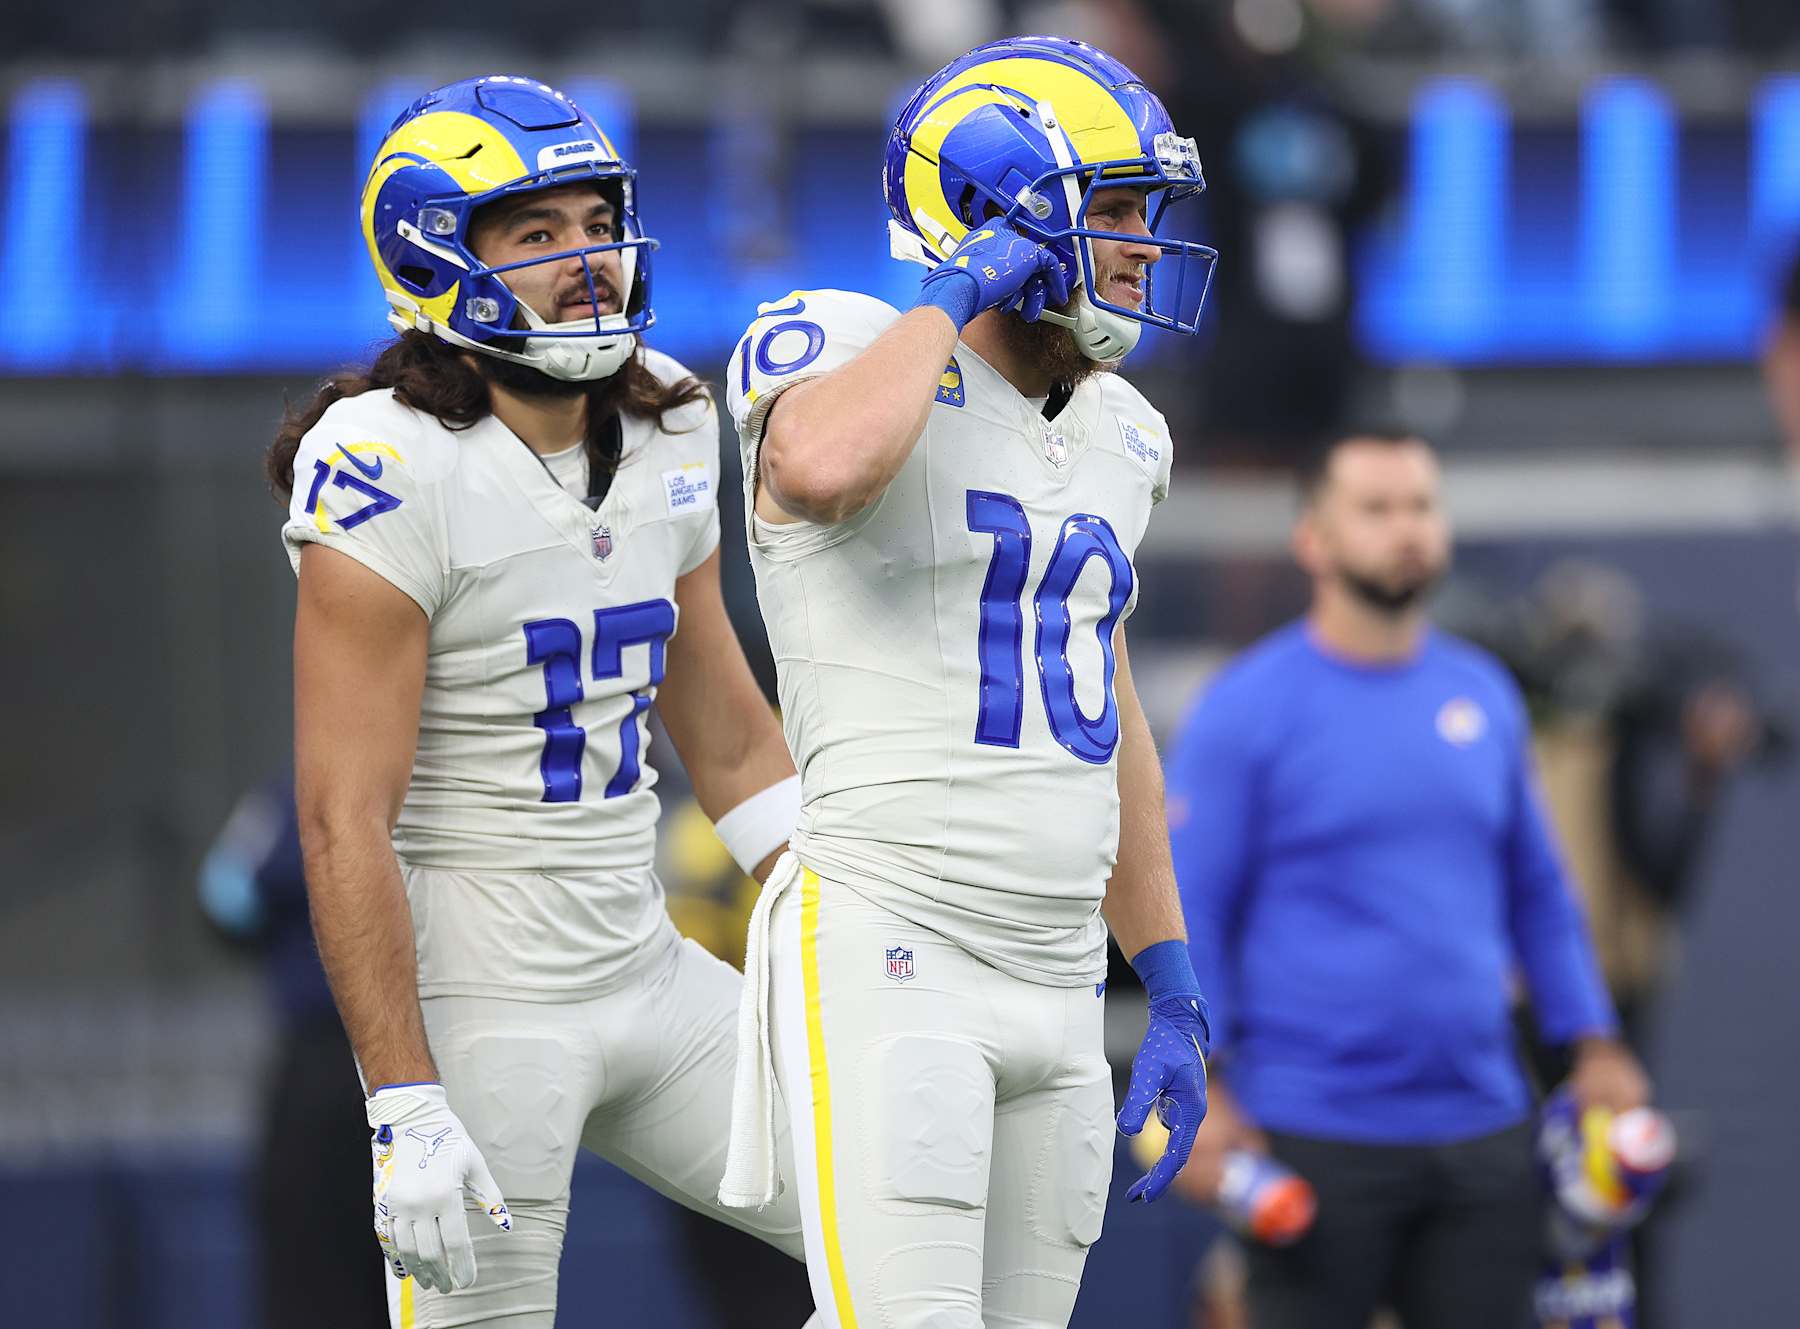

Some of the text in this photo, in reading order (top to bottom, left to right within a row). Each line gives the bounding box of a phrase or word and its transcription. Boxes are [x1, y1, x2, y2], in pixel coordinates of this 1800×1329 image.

[553, 142, 595, 157] RAMS
[741, 320, 826, 397] 10
[1121, 422, 1140, 438] LOS
[1125, 432, 1160, 461] ANGELES
[1126, 440, 1147, 462] RAMS
[667, 475, 686, 488] LOS
[670, 481, 709, 498] ANGELES
[304, 458, 403, 531] 17
[671, 494, 697, 507] RAMS
[965, 488, 1134, 765] 10
[523, 598, 675, 802] 17
[889, 960, 912, 976] NFL
